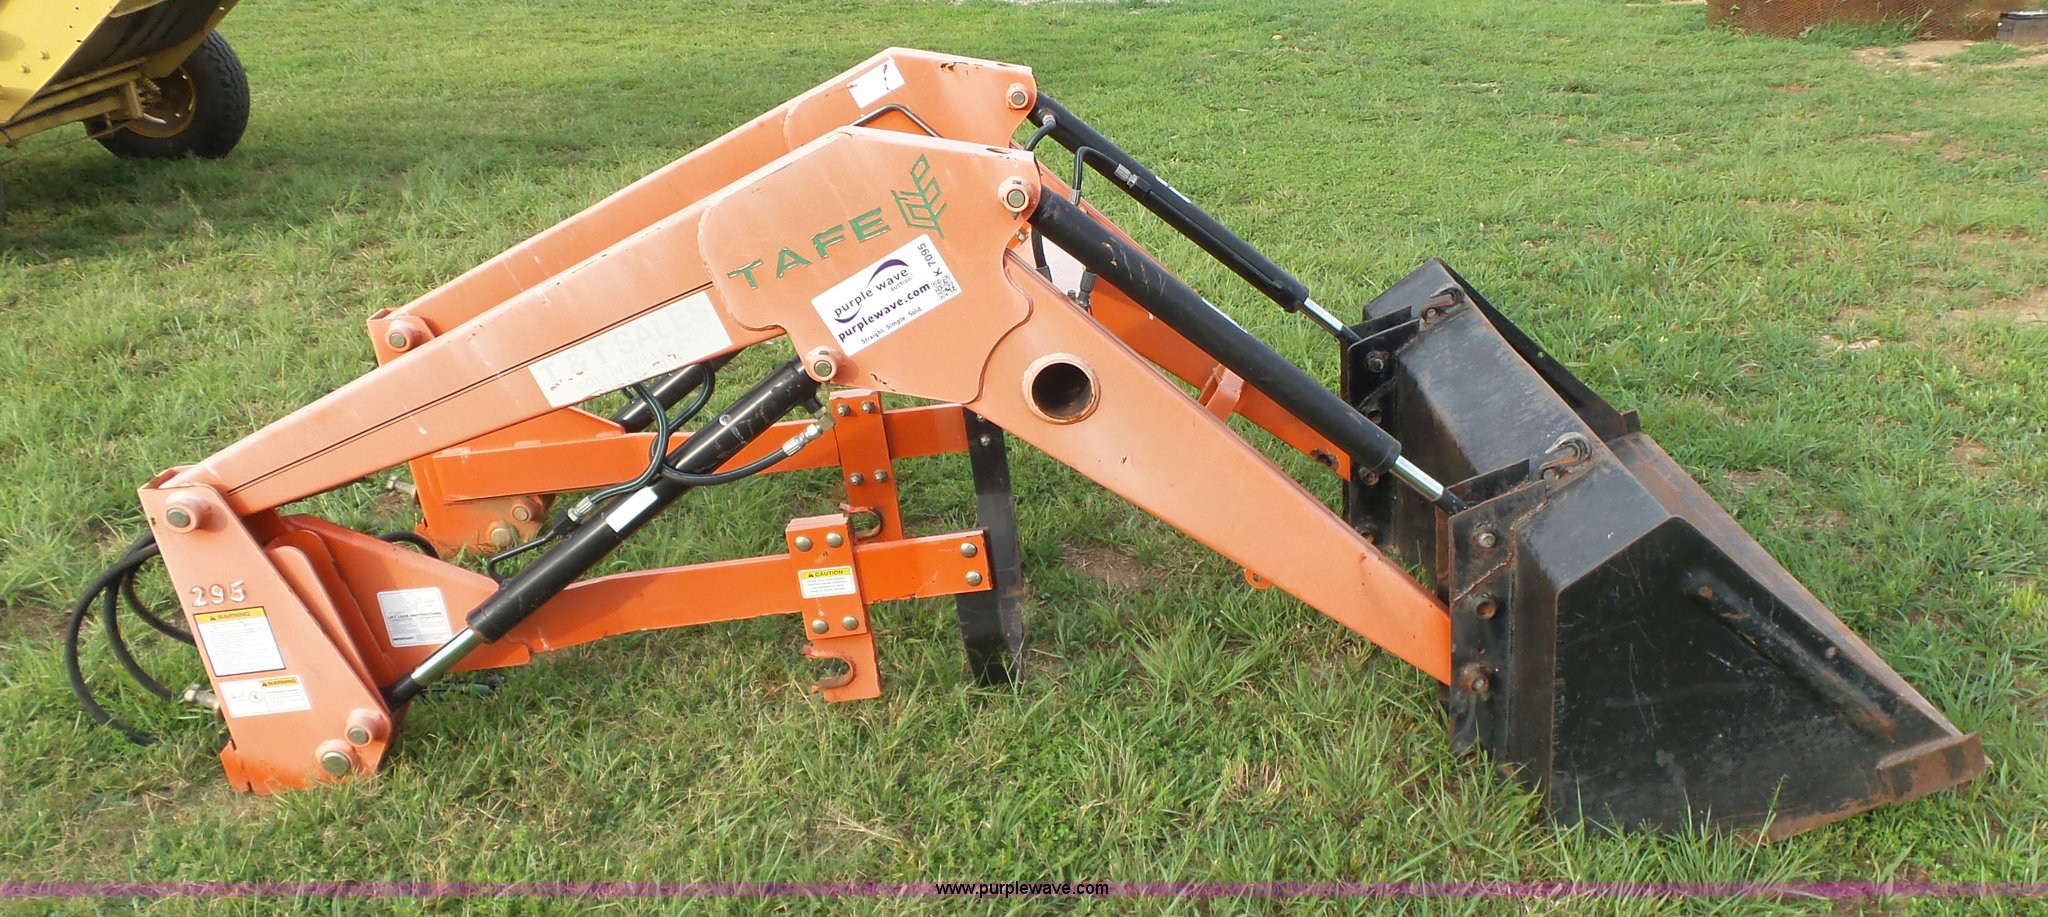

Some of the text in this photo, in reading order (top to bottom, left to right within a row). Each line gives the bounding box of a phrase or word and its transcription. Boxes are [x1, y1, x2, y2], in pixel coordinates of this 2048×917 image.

[727, 207, 891, 289] TAFE
[917, 242, 943, 276] K 7095
[834, 268, 909, 317] purple wave
[891, 277, 910, 292] auction
[613, 299, 710, 353] SALES
[838, 283, 931, 342] purplewave.com
[861, 328, 886, 344] Straight.
[886, 316, 907, 330] Simple.
[815, 569, 844, 578] CAUTION
[190, 580, 246, 607] 295
